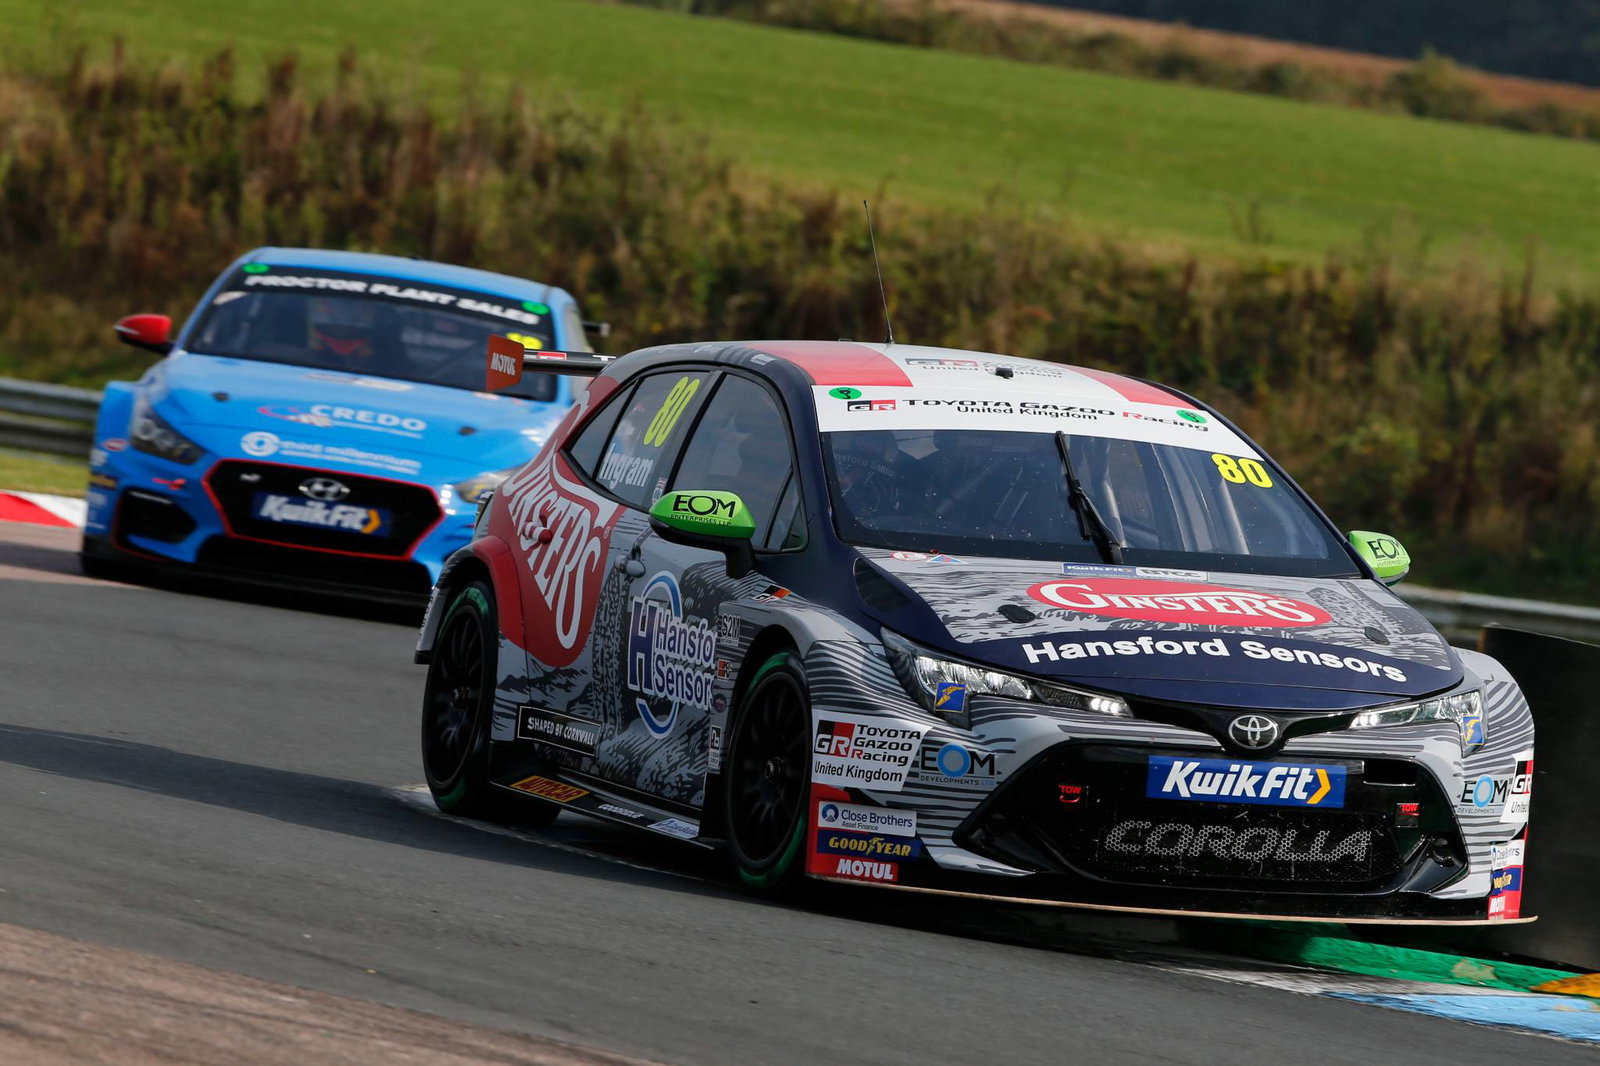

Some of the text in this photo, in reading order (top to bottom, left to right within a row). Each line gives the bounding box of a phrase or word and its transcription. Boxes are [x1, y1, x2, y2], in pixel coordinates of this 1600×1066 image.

[245, 275, 540, 325] PROCTOR PLANT SALES
[311, 404, 427, 432] CREDO
[643, 376, 700, 448] 80
[903, 400, 1012, 408] TOYOTA
[1020, 402, 1115, 416] GAZOO
[1122, 411, 1208, 432] Racing
[957, 406, 1098, 421] United Kingdom
[600, 443, 654, 490] Ingram
[1211, 453, 1274, 489] 80
[672, 494, 736, 519] EOM
[670, 514, 717, 525] ENTERPRISES
[655, 609, 716, 668] Hansfo
[1022, 637, 1408, 683] Hansford Sensors
[527, 717, 595, 746] SHAPED BY CORNWALL
[814, 728, 854, 758] GR
[856, 723, 922, 740] TOYOTA
[853, 737, 913, 752] GAZOO
[851, 749, 909, 767] Racing
[920, 743, 995, 778] EOM
[814, 761, 903, 783] United Kingdom
[920, 775, 980, 786] DEVELOPMENTS
[1059, 785, 1082, 794] TOW
[1460, 776, 1508, 808] EOM
[841, 810, 913, 828] Close Brothers
[1400, 803, 1419, 813] TOW
[841, 821, 879, 831] Asset Finance
[829, 837, 912, 857] GOODYEAR
[1104, 821, 1372, 861] COROLLA
[836, 858, 894, 880] MOTUL
